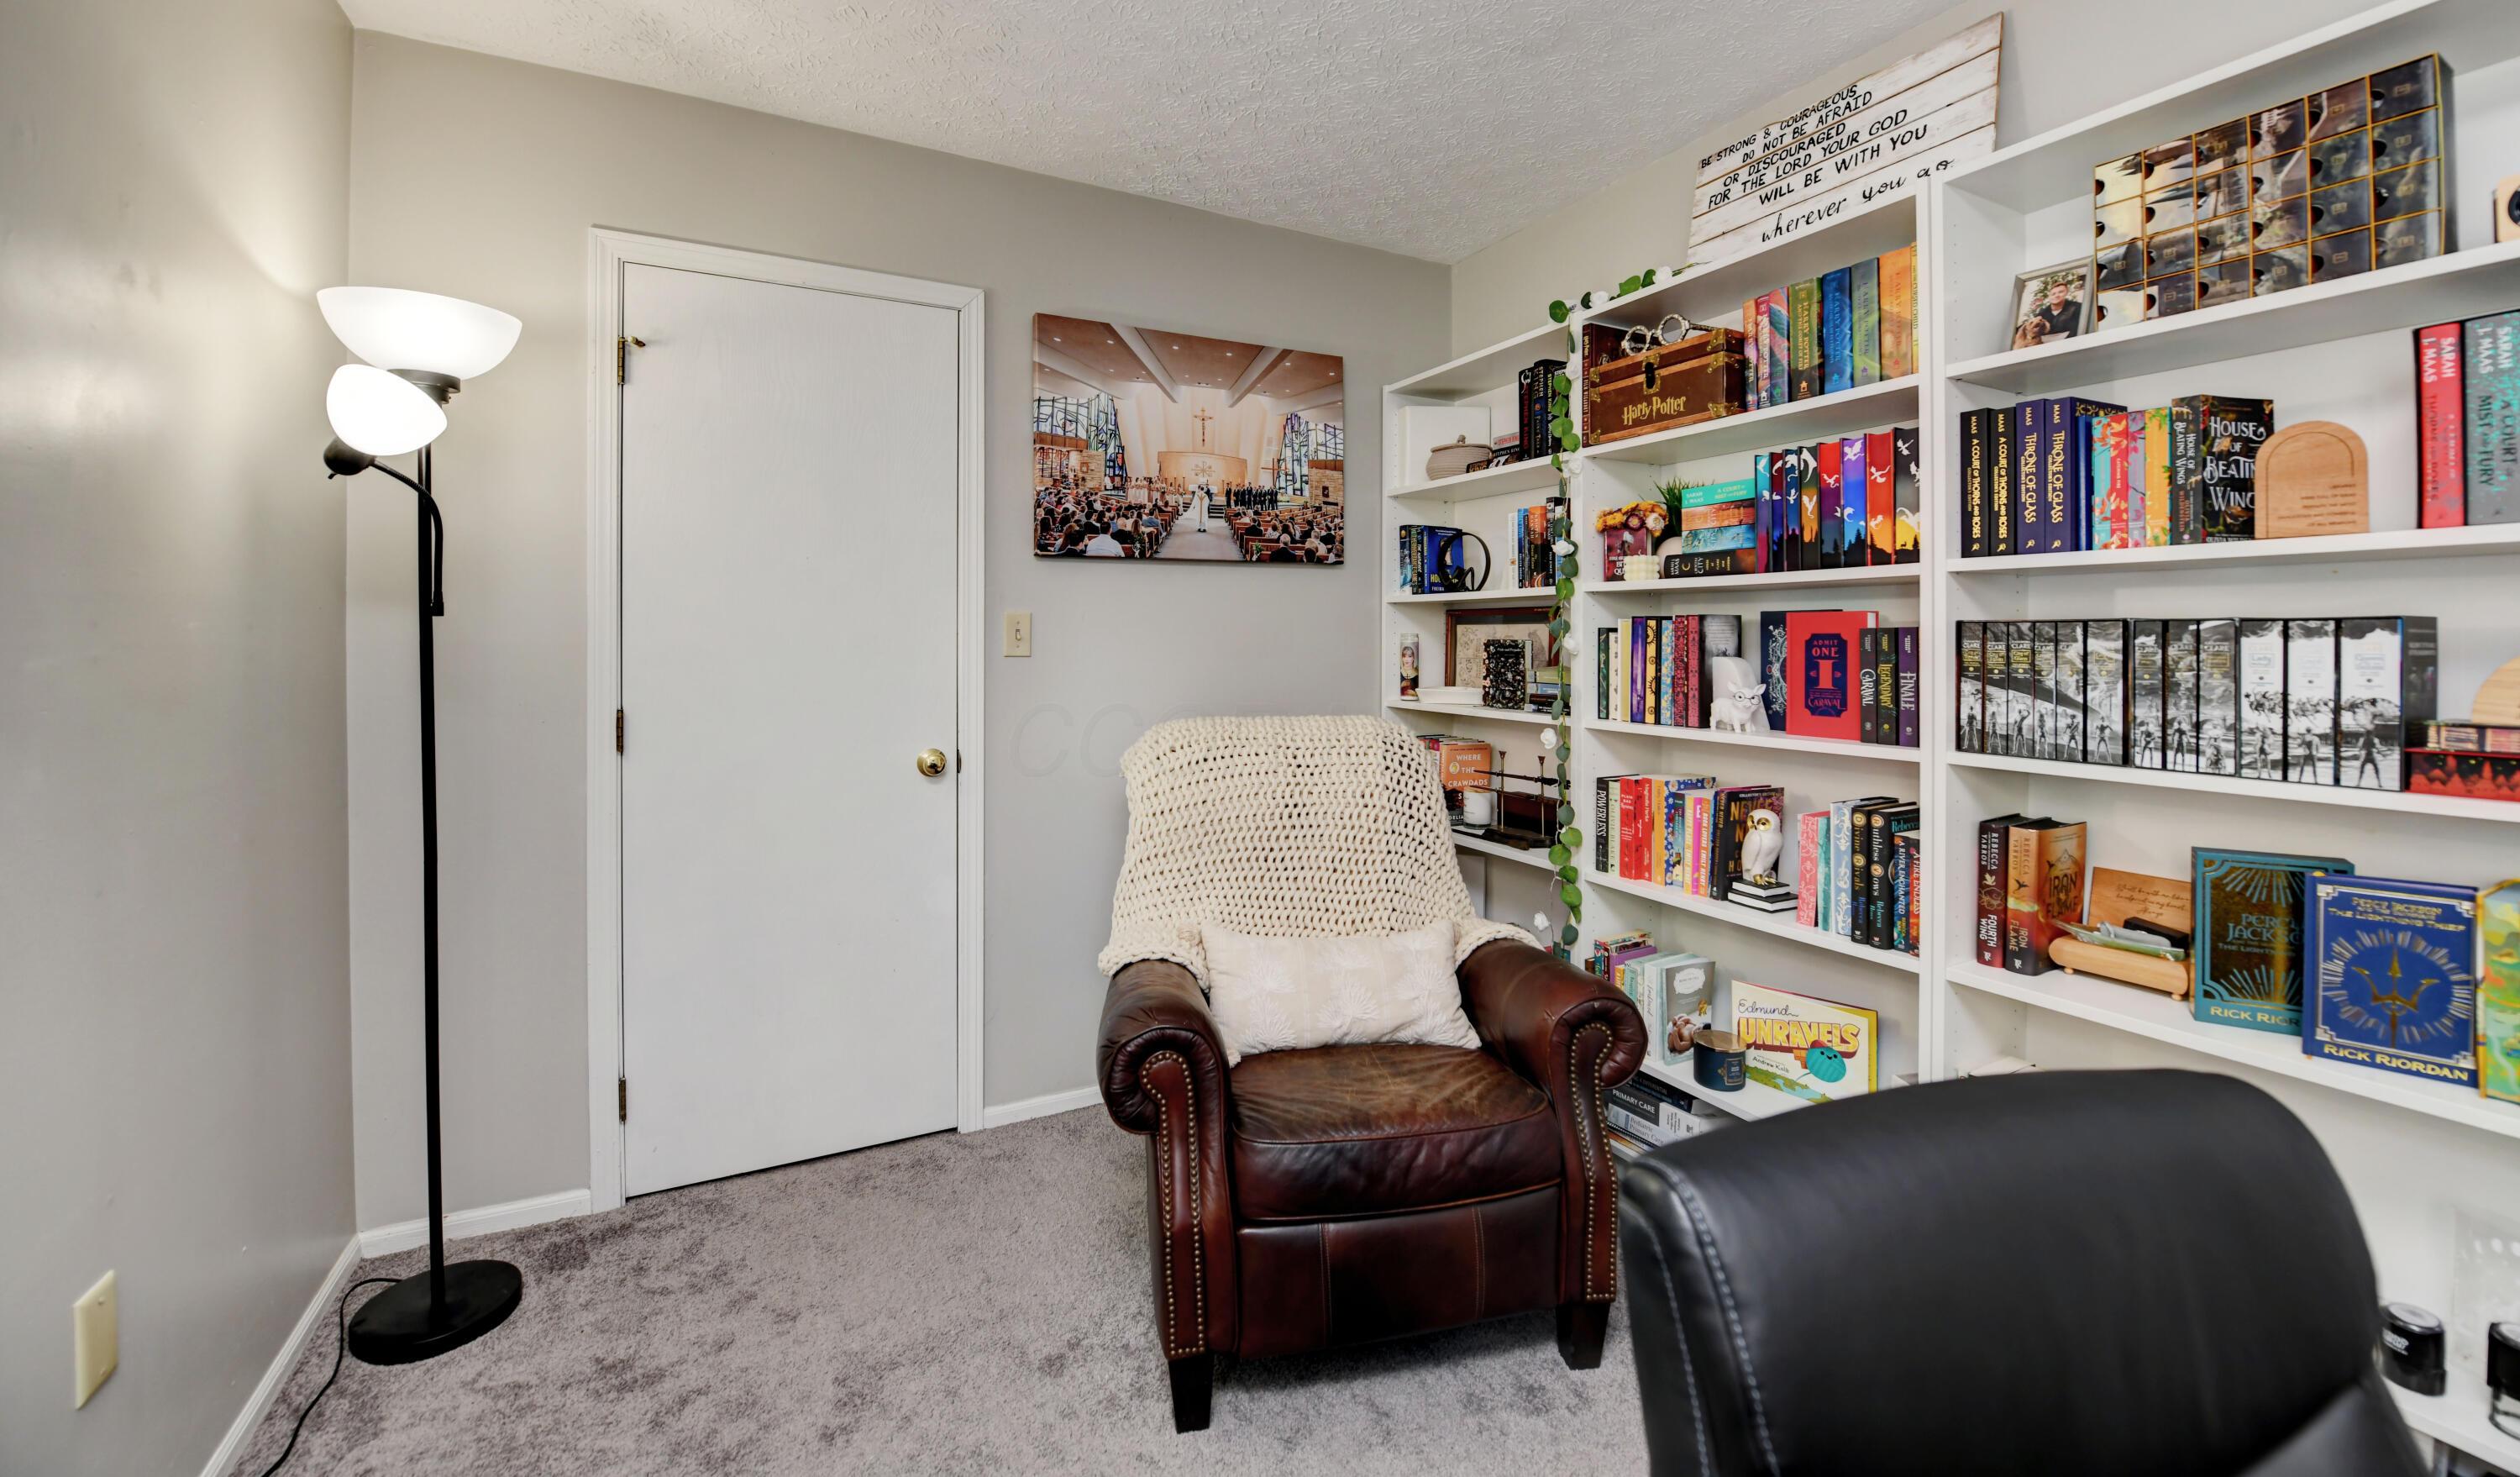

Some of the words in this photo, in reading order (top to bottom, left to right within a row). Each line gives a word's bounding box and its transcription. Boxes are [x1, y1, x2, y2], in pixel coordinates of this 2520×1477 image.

[1701, 157, 1715, 169] BE
[1716, 134, 1757, 161] STRONG
[1763, 128, 1772, 139] &
[1779, 85, 1858, 130] COURAGEOUS
[1742, 149, 1755, 163] DO
[1763, 137, 1785, 154] NOT
[1792, 124, 1808, 139] BE
[1816, 92, 1872, 129] AFRAID
[1709, 189, 1731, 209] FOR
[1741, 177, 1766, 194] THE
[1775, 155, 1812, 180] LORD
[1821, 133, 1860, 158] YOUR
[1868, 109, 1908, 136] GOD
[1723, 172, 1740, 187] OR
[1747, 123, 1846, 177] DISCOURAGED
[1759, 183, 1795, 206] WILL
[1803, 171, 1823, 187] BE
[1835, 145, 1881, 174] WITH
[1889, 124, 1928, 152] YOU
[1761, 197, 1847, 243] wherever
[1862, 176, 1907, 203] you
[2441, 336, 2455, 378] SARAH
[2479, 338, 2494, 374] MAAS
[2497, 326, 2513, 369] SARAH
[2423, 347, 2438, 384] MAAS
[1622, 402, 1652, 425] Harry
[1652, 396, 1687, 420] Potter
[2478, 395, 2493, 428] MIST
[2501, 399, 2512, 410] A
[2174, 421, 2187, 457] BEATING
[2210, 416, 2266, 441] HOUSE
[2502, 414, 2517, 465] COURT
[1999, 444, 2007, 468] COURT
[2024, 433, 2037, 474] THRONE
[2052, 430, 2065, 473] THRONE
[2187, 433, 2197, 458] HOUSE
[2229, 442, 2243, 452] OF
[2175, 457, 2187, 485] WINGS
[2187, 460, 2196, 470] OF
[2479, 450, 2494, 487] FURY
[1999, 476, 2007, 505] THORNS
[2026, 474, 2036, 491] OF
[2053, 474, 2063, 491] OF
[2024, 492, 2037, 523] GLASS
[2050, 492, 2063, 523] GLASS
[1972, 517, 1981, 539] ROSES
[1999, 517, 2007, 539] ROSES
[1812, 647, 1839, 657] ONE
[1861, 669, 1876, 706] CARAVAL
[1877, 664, 1893, 708] LEGENDARY
[1900, 671, 1916, 710] FINALE
[1808, 699, 1847, 710] CARAVAL
[1597, 790, 1606, 836] POWERLESS
[1853, 815, 1866, 851] Divine
[1872, 816, 1884, 861] Ruthless
[1853, 856, 1866, 891] Rivals
[1871, 865, 1883, 896] Vows
[2328, 907, 2353, 917] THE
[2355, 913, 2423, 927] LIGHTNING
[2426, 920, 2467, 931] THIEF
[2352, 897, 2389, 909] PERCY
[2391, 902, 2442, 915] JACKSON
[1979, 918, 1987, 940] WING
[1987, 915, 1998, 947] FOURTH
[2009, 920, 2019, 951] FLAME
[2019, 927, 2028, 948] IRON
[2227, 923, 2303, 943] JACKSO
[1738, 999, 1794, 1017] Edmund
[2210, 1006, 2253, 1021] RICK
[2257, 1012, 2300, 1028] RIOR
[1738, 1017, 1861, 1057] UNRAVELS
[1753, 1056, 1774, 1068] Andrew
[2323, 1043, 2370, 1062] RICK
[2375, 1054, 2469, 1081] RIORDAN
[1612, 1089, 1638, 1106] PRIMARY
[1638, 1101, 1656, 1114] CARE
[1629, 1124, 1651, 1140] Primary
[1630, 1114, 1654, 1133] Pediatric
